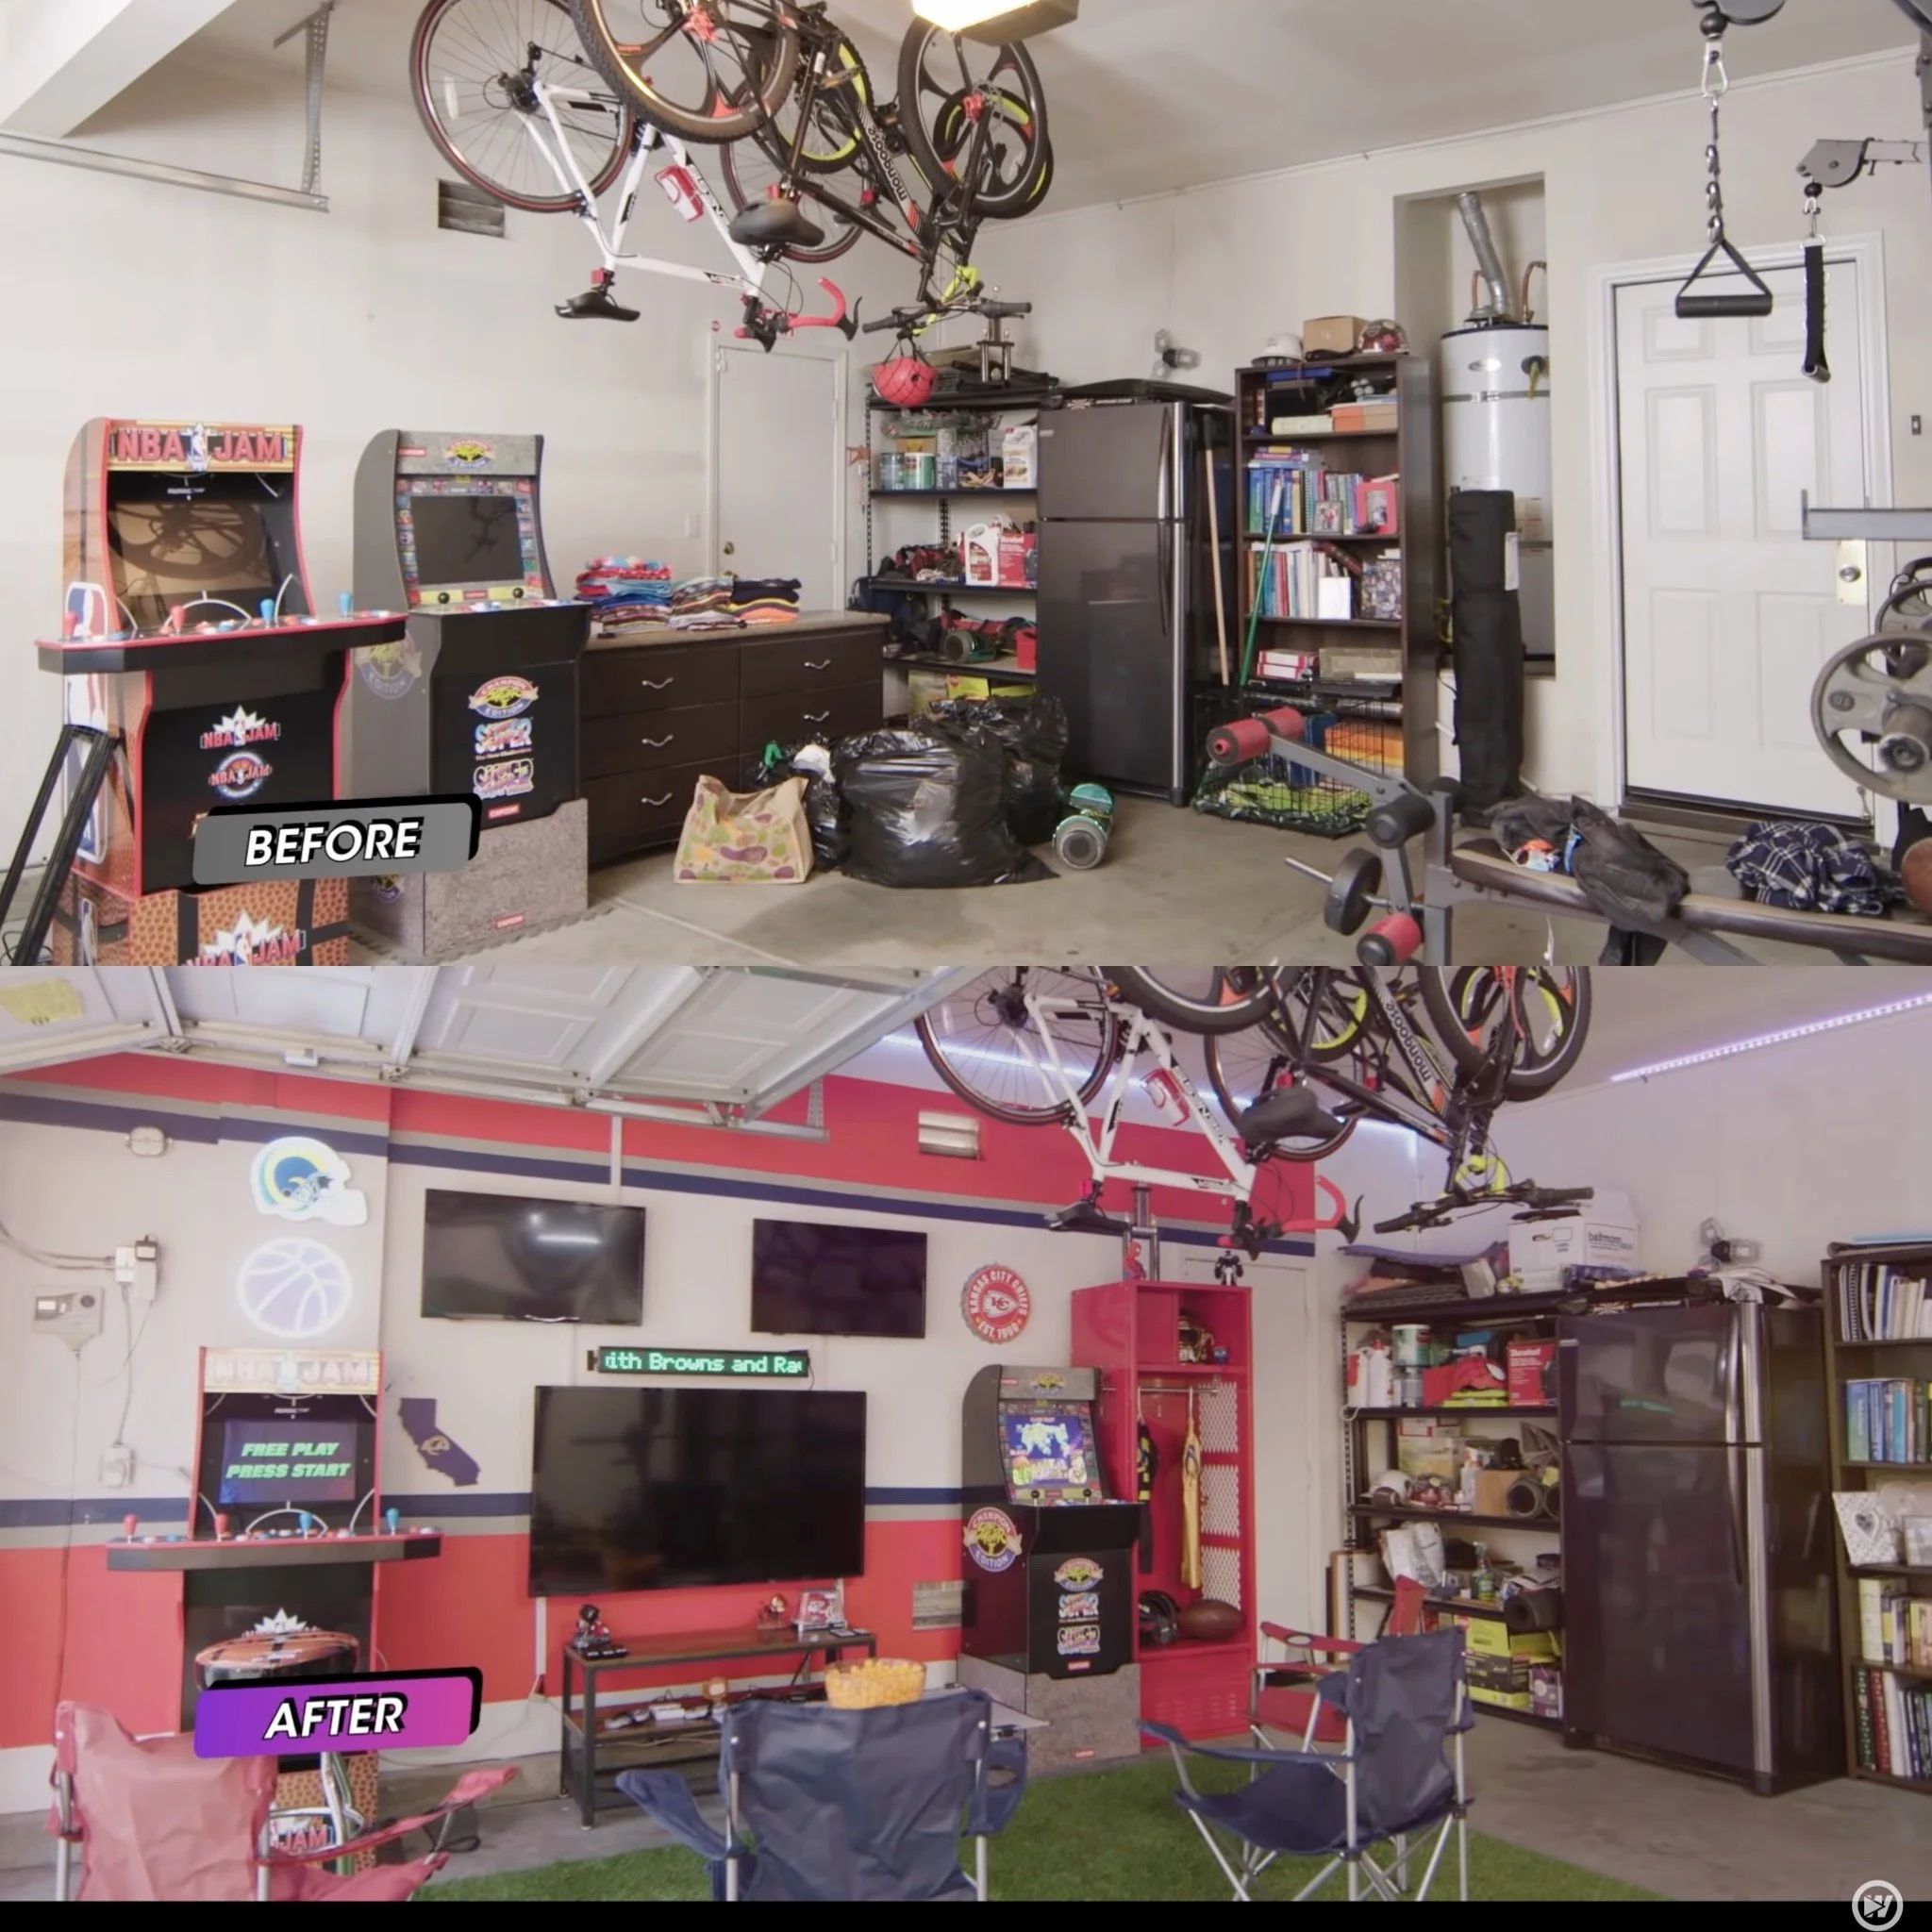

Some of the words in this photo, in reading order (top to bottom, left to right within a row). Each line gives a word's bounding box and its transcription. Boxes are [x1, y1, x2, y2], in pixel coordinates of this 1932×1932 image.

[117, 428, 185, 461] NBA
[214, 430, 283, 461] JAM
[203, 730, 234, 749] NBA
[245, 722, 278, 742] JAM
[210, 770, 236, 786] NBA
[246, 764, 271, 779] JAM
[252, 929, 301, 962] JAM
[1385, 1002, 1432, 1082] mongoose
[990, 1270, 1012, 1283] CITY
[303, 1359, 370, 1385] JAM
[649, 1353, 724, 1371] Browns
[732, 1357, 777, 1373] and
[242, 1442, 289, 1457] FREE
[291, 1442, 340, 1457] PLAY
[225, 1464, 289, 1479] PRESS
[291, 1463, 351, 1478] START
